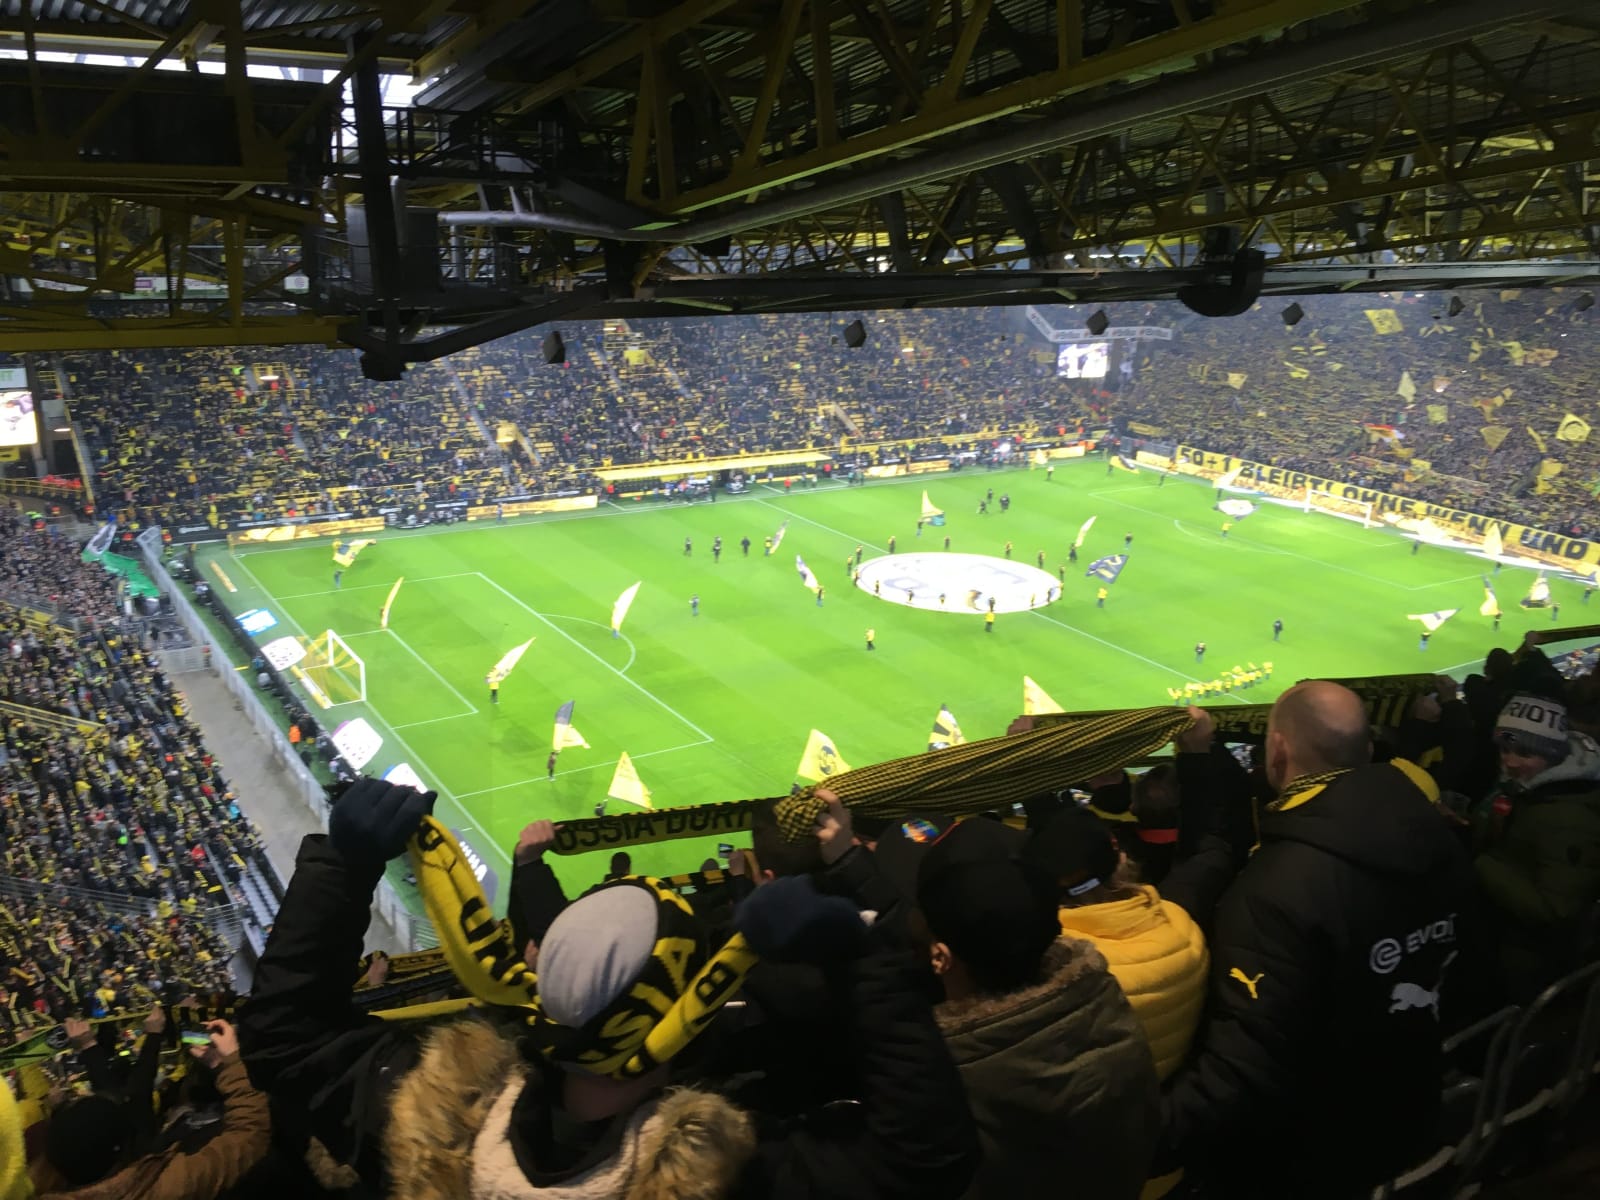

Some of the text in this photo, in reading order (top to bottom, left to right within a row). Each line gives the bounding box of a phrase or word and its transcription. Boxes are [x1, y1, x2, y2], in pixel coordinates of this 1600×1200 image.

[1180, 447, 1232, 472] 50+1
[1342, 486, 1415, 514] OHNE
[1520, 528, 1588, 559] UND
